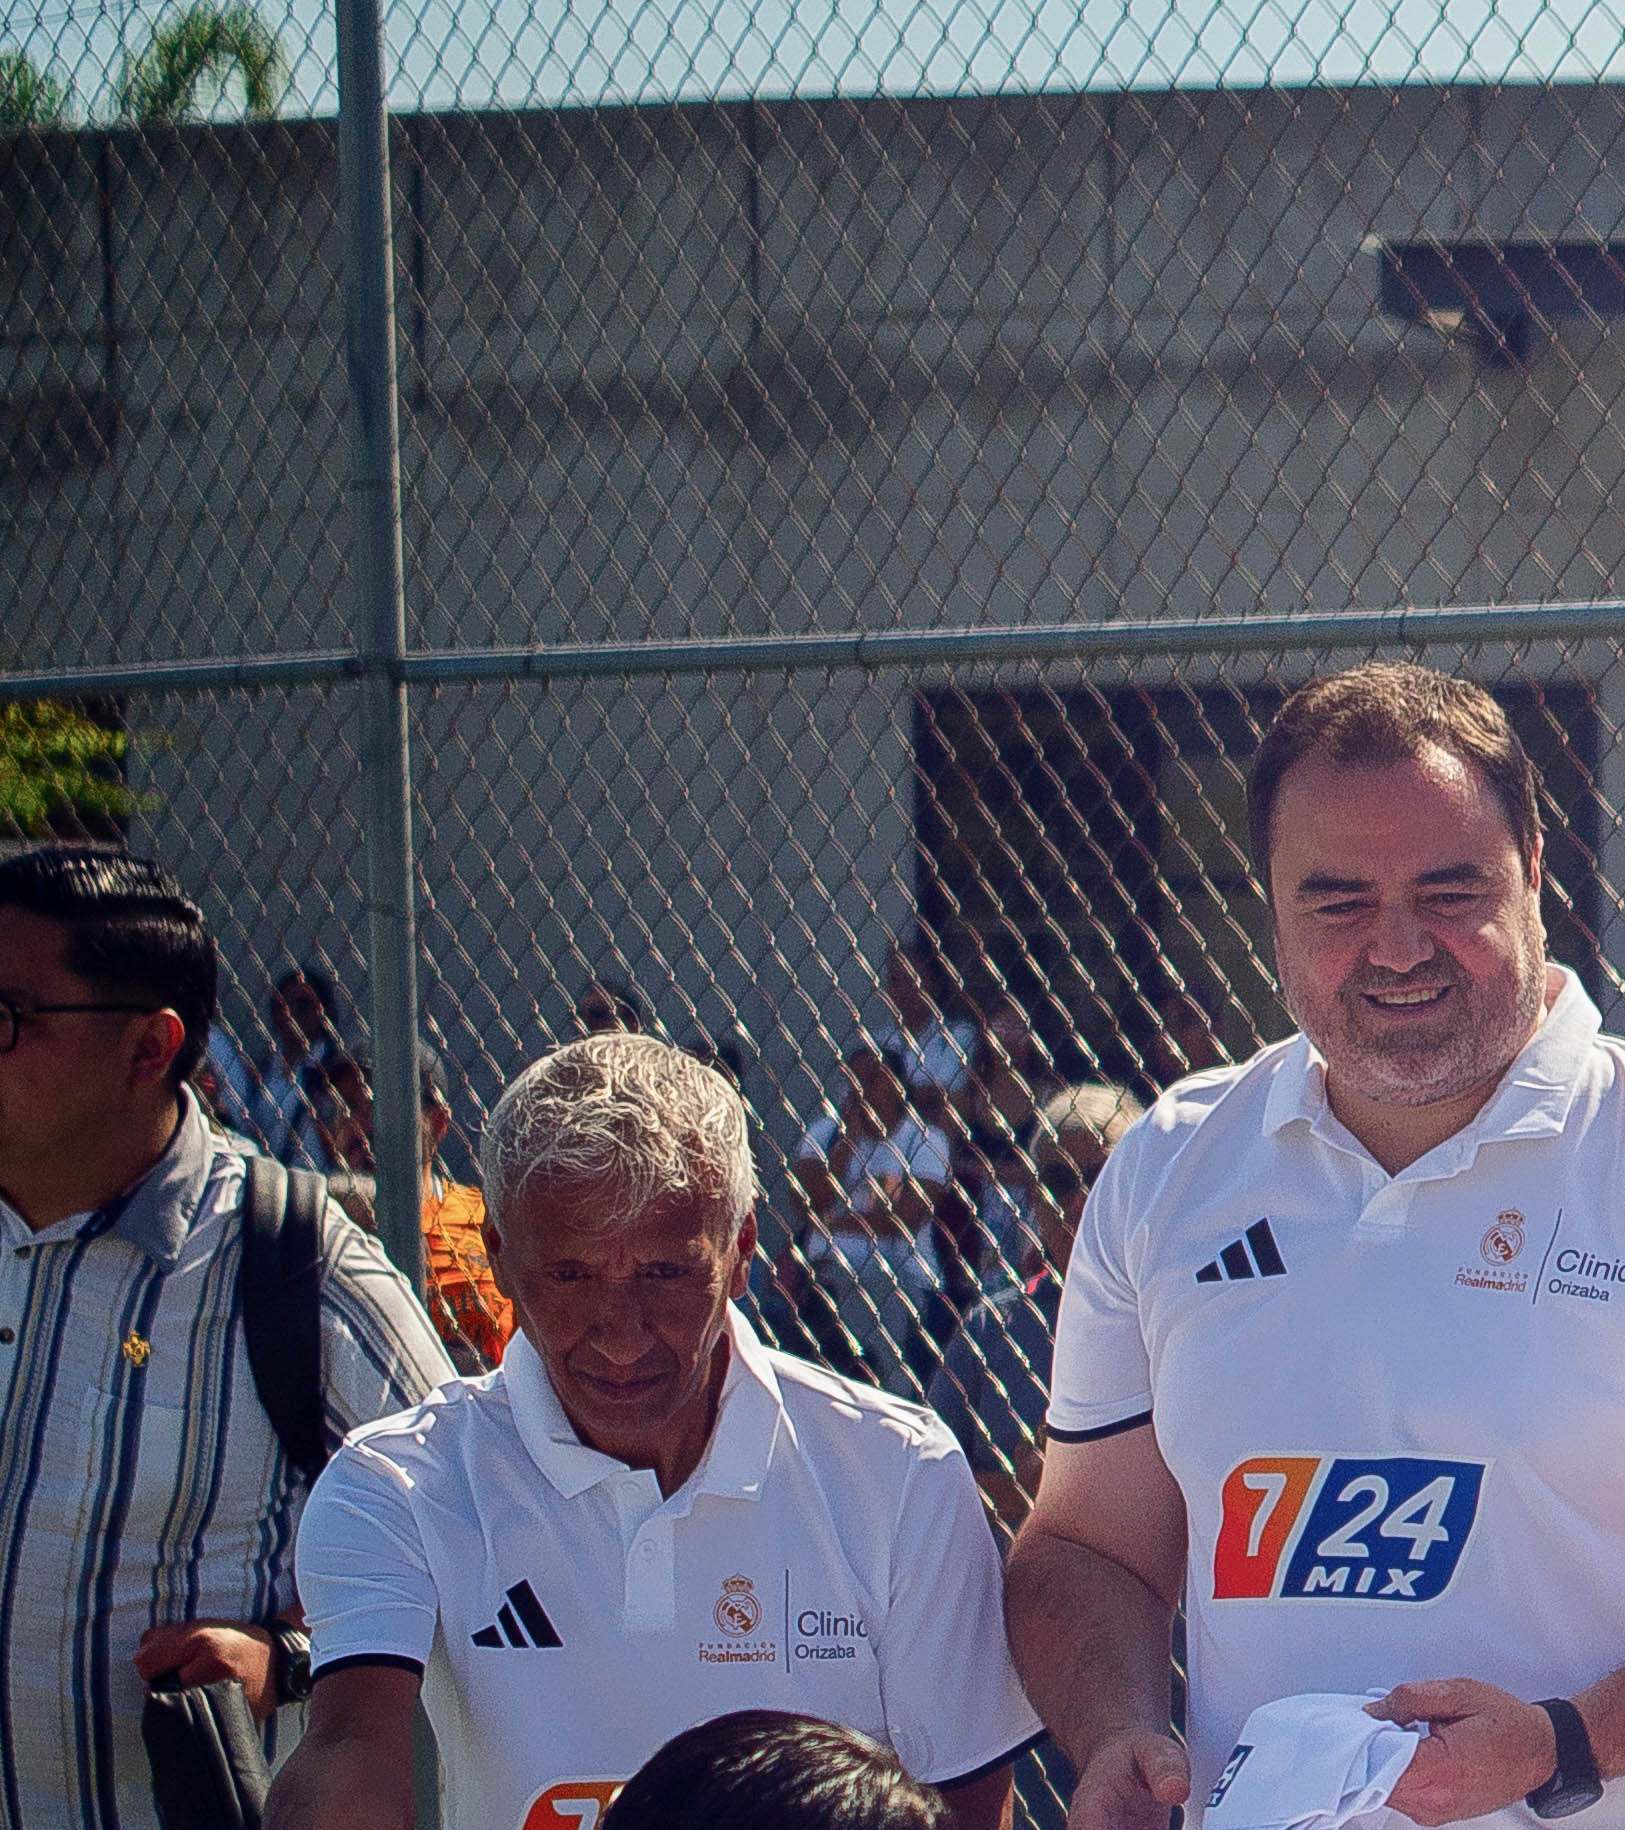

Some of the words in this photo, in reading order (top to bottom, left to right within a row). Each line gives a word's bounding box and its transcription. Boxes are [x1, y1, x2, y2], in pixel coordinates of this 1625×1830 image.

[1548, 1278, 1611, 1301] Orizaba
[1243, 1472, 1288, 1558] 7
[1317, 1474, 1456, 1561] 24
[1303, 1566, 1425, 1597] MIX
[797, 1610, 869, 1637] Clinic
[699, 1649, 776, 1663] Realmadrid
[795, 1643, 856, 1660] Orizaba
